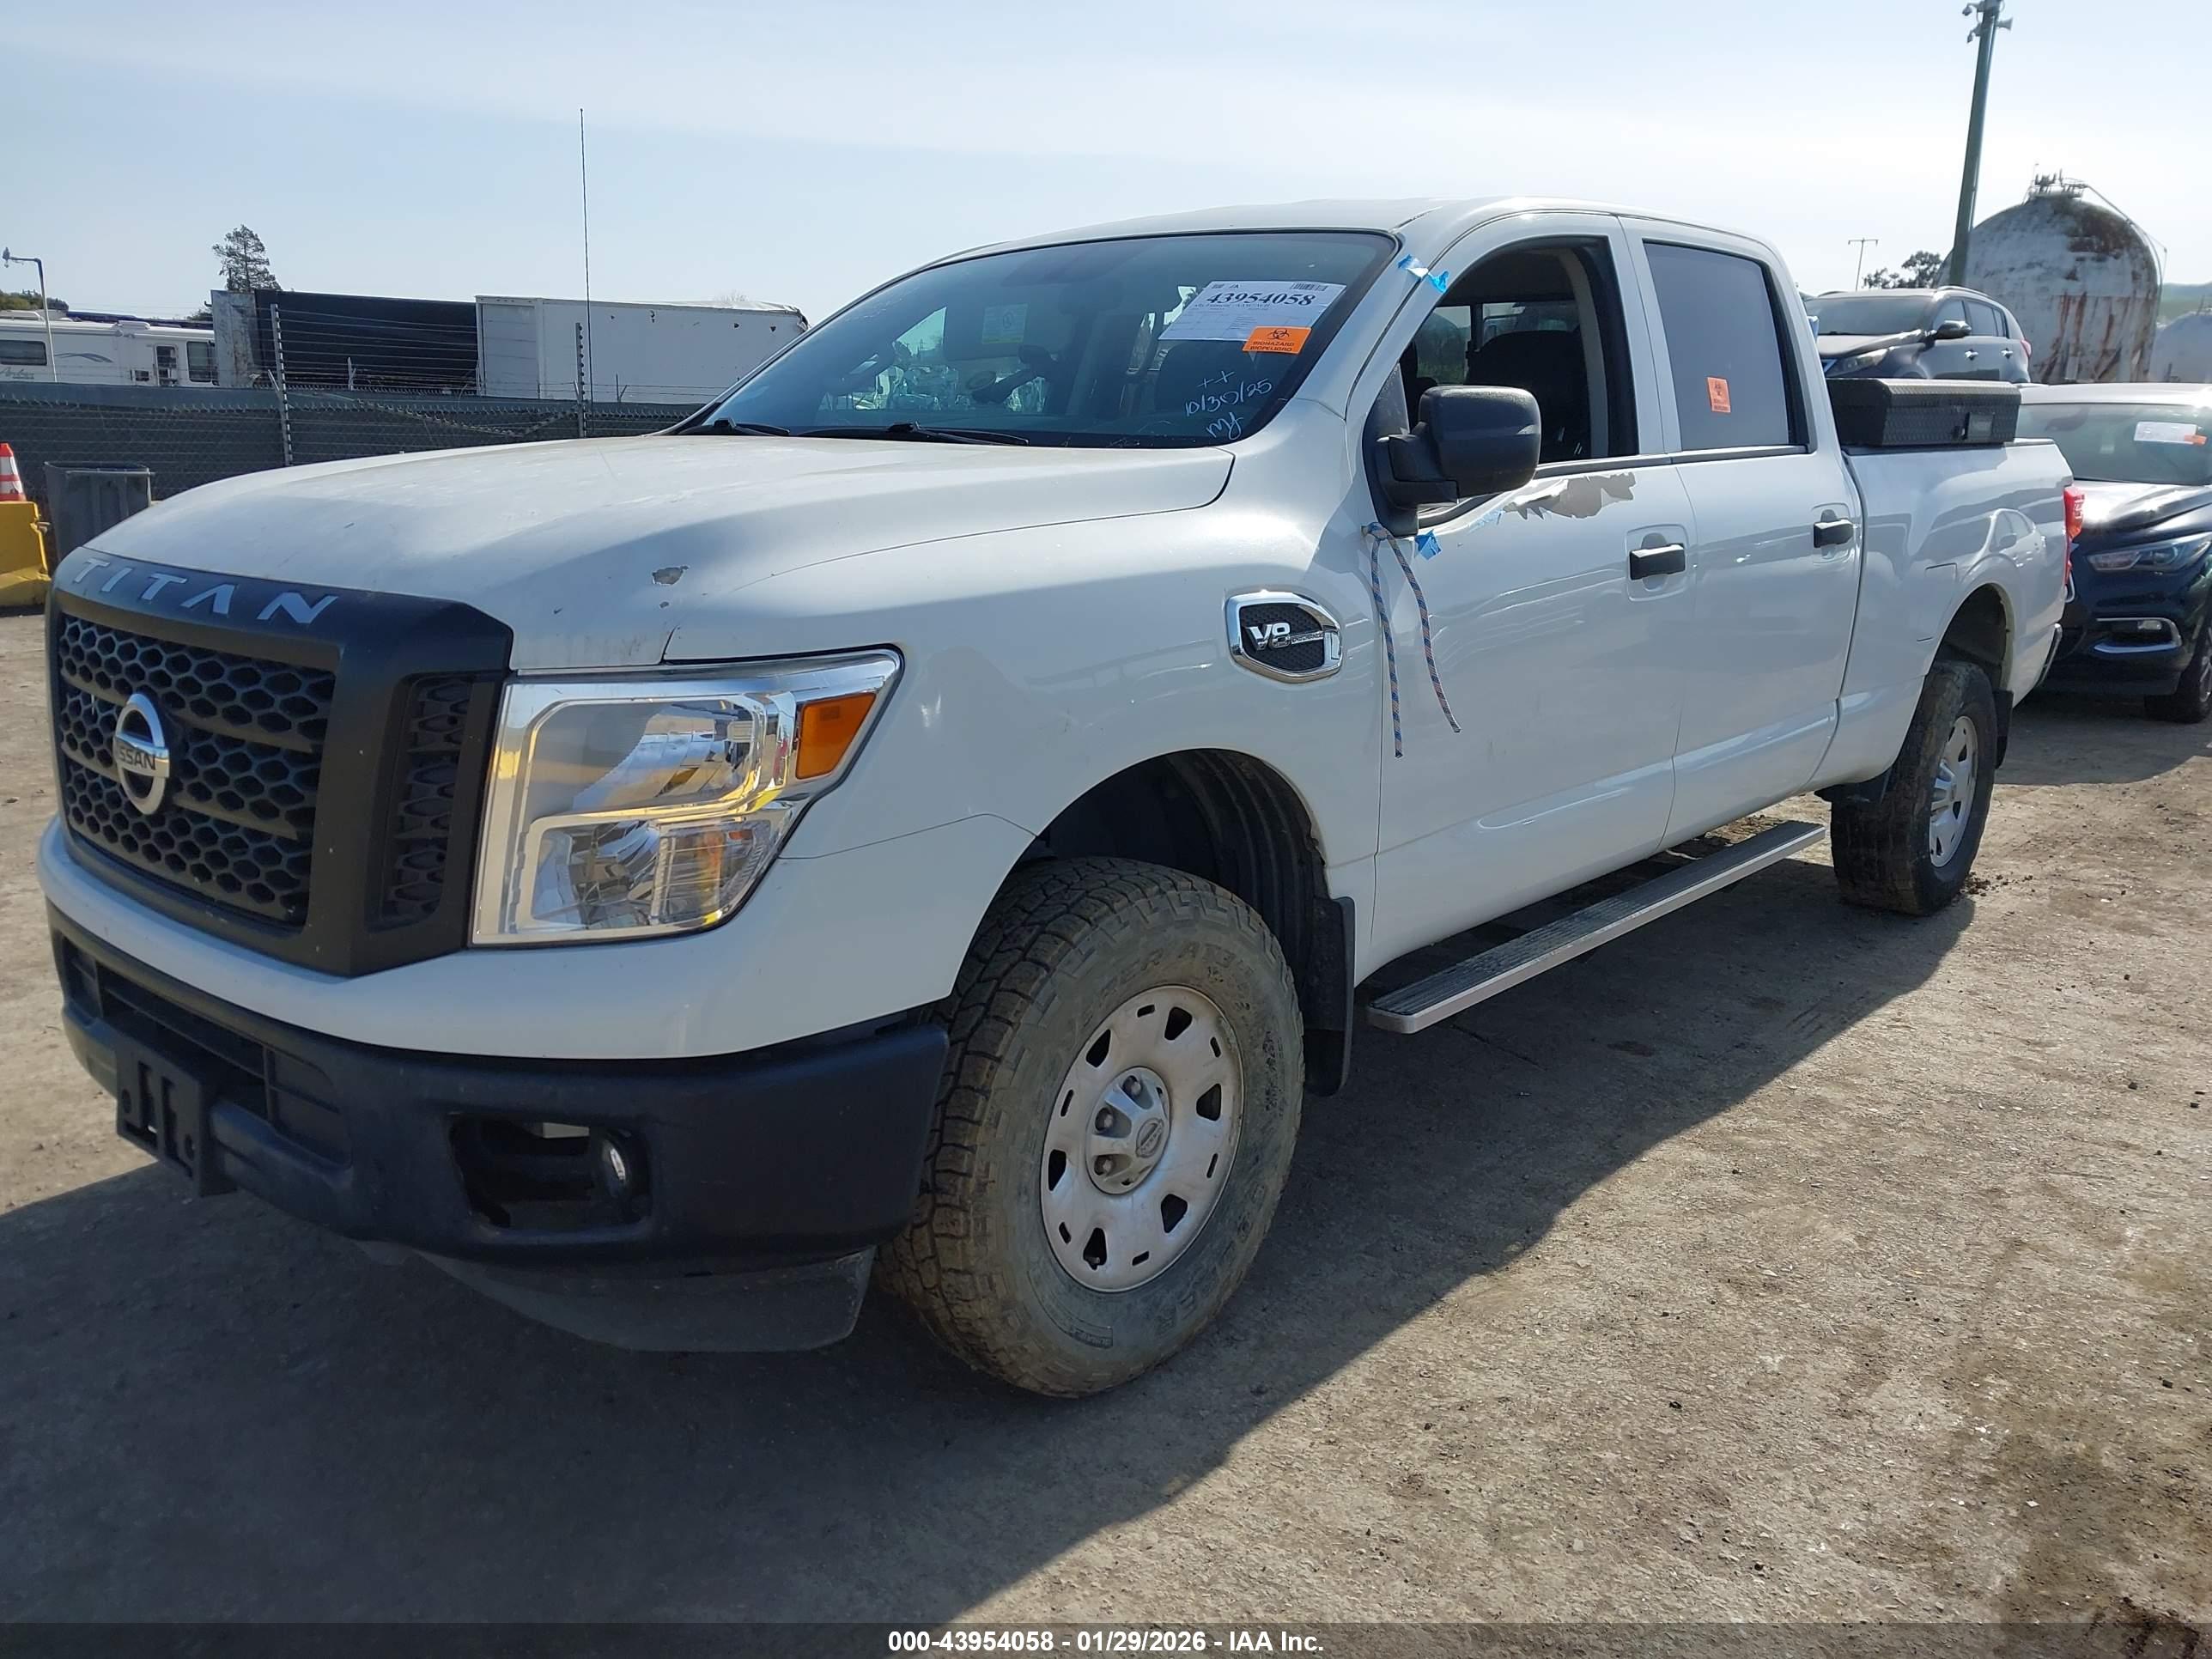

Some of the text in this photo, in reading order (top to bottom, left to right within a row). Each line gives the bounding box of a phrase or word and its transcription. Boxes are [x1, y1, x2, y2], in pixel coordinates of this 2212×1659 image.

[1206, 292, 1316, 307] 43954058
[1186, 378, 1273, 417] 10/30/25
[74, 558, 339, 624] TITAN
[1248, 622, 1291, 648] V8
[116, 744, 157, 771] SSAN
